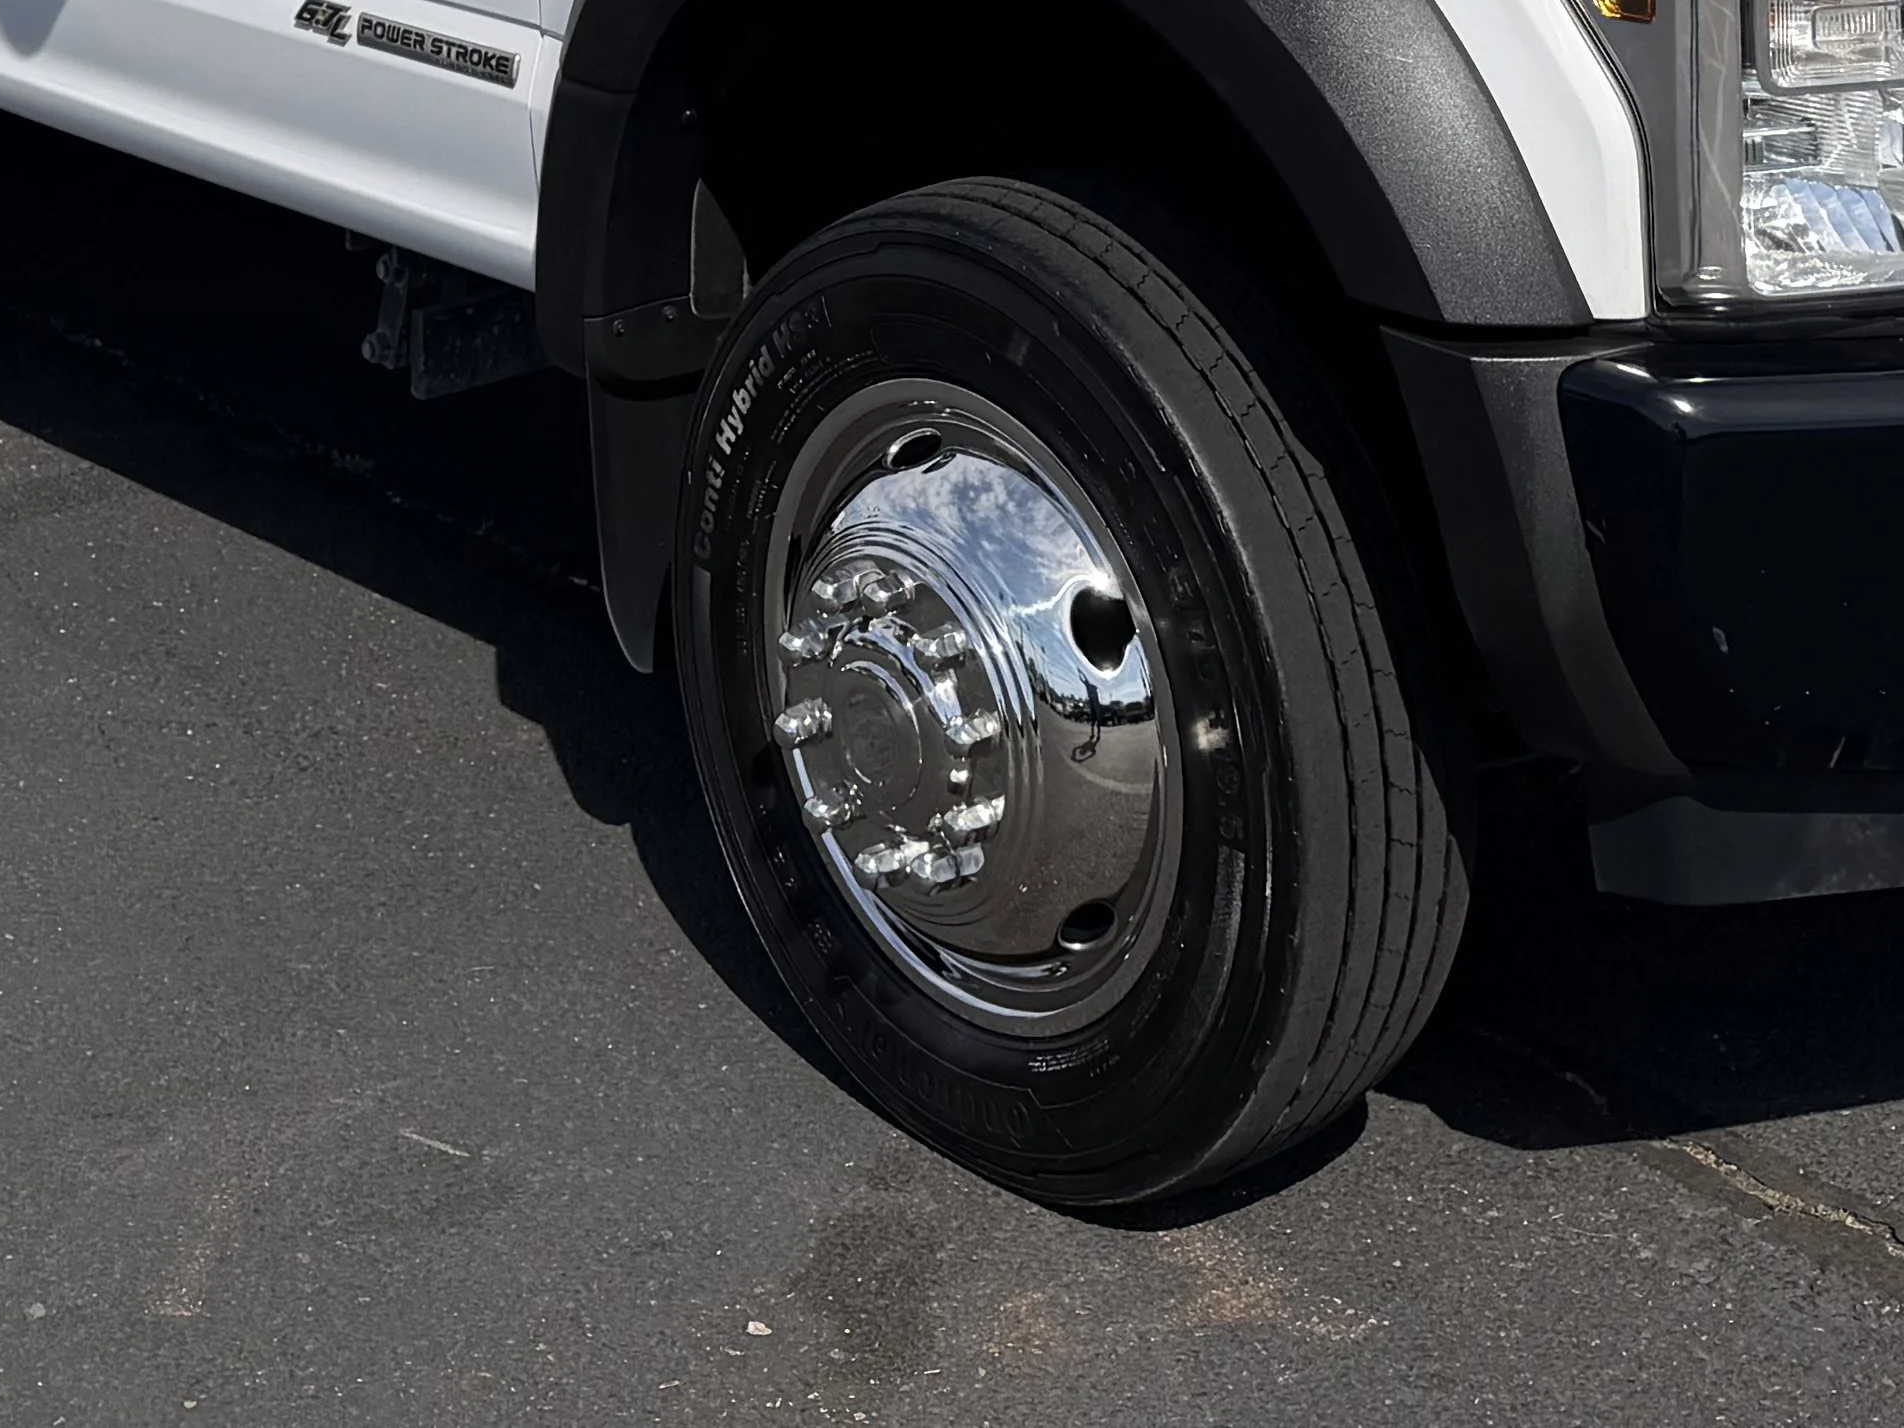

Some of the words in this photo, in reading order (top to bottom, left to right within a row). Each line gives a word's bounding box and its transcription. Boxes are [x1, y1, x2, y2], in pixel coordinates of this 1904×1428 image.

[360, 17, 425, 51] POWER
[430, 37, 509, 75] STROKE
[715, 344, 776, 455] Hybrid
